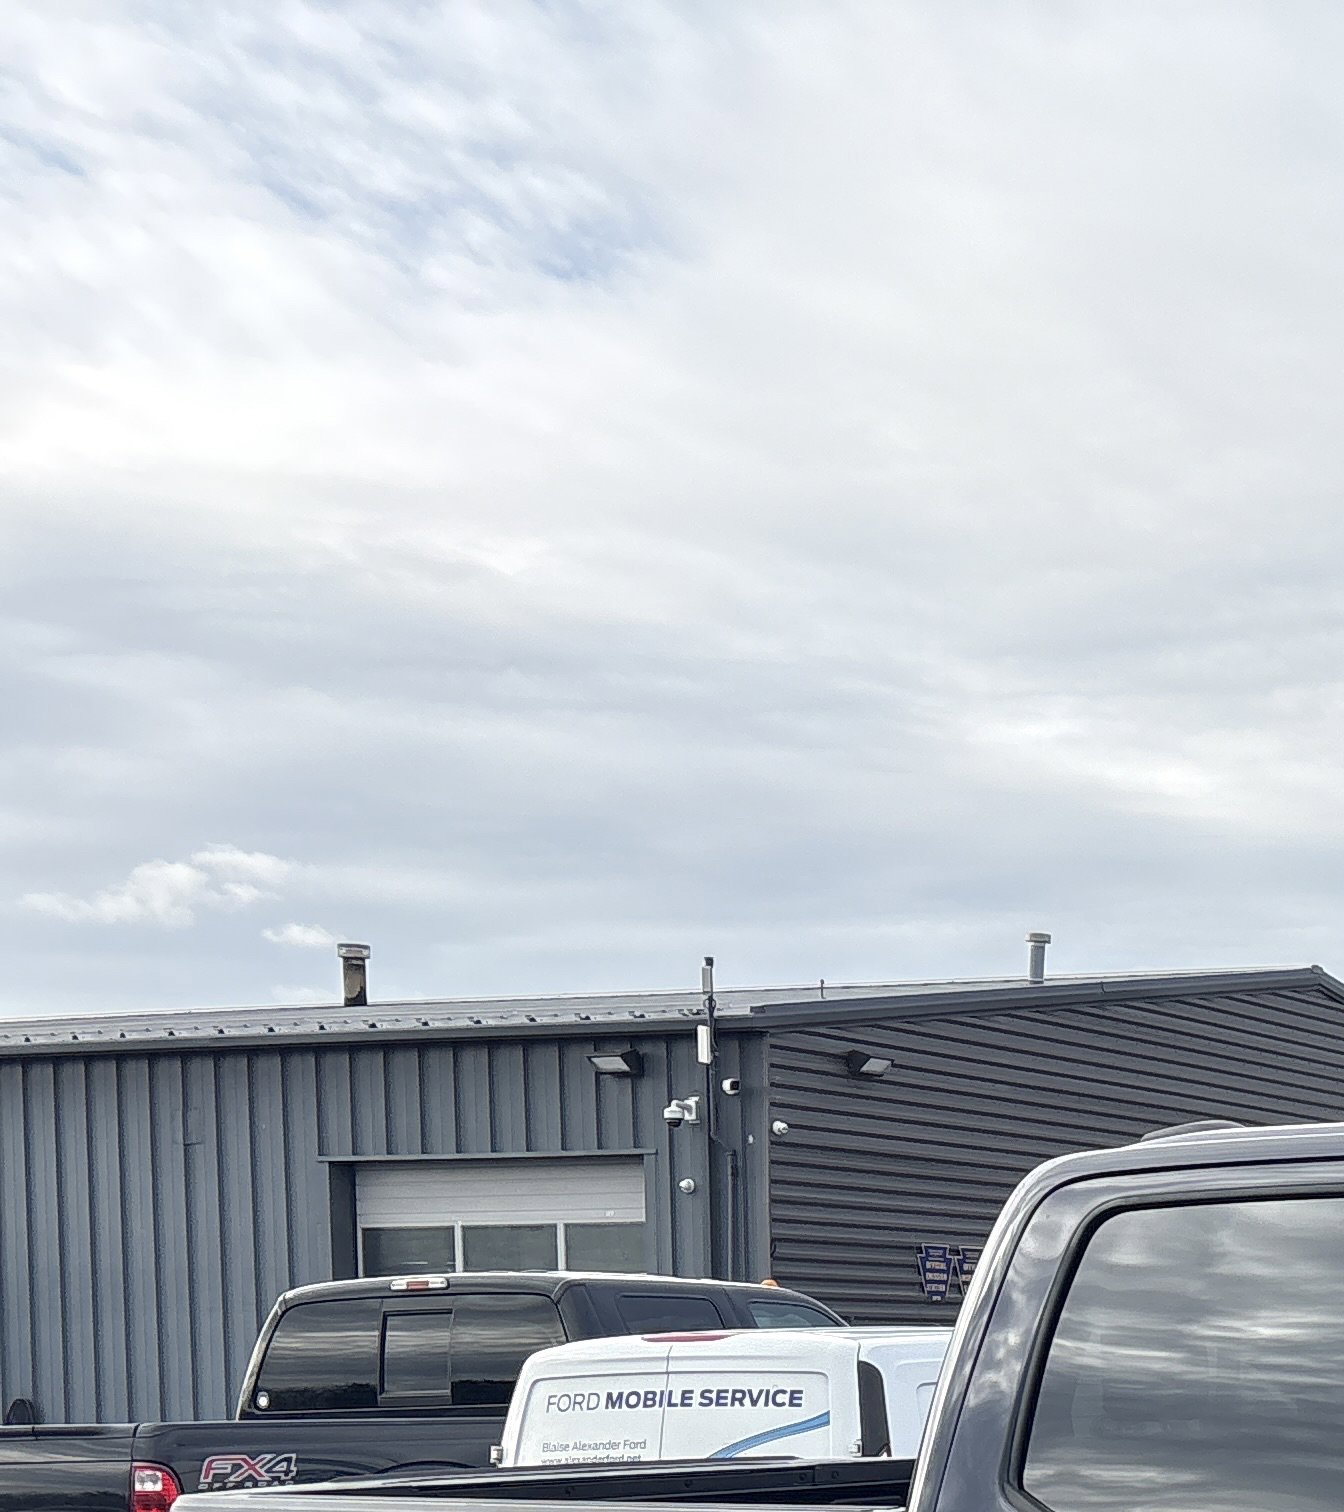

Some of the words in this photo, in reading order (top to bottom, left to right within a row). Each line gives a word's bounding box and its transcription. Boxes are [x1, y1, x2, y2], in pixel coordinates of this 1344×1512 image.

[545, 1391, 601, 1414] FORD
[604, 1388, 695, 1410] MOBILE
[698, 1388, 804, 1409] SERVICE
[622, 1438, 648, 1450] Ford
[199, 1452, 298, 1483] FX4
